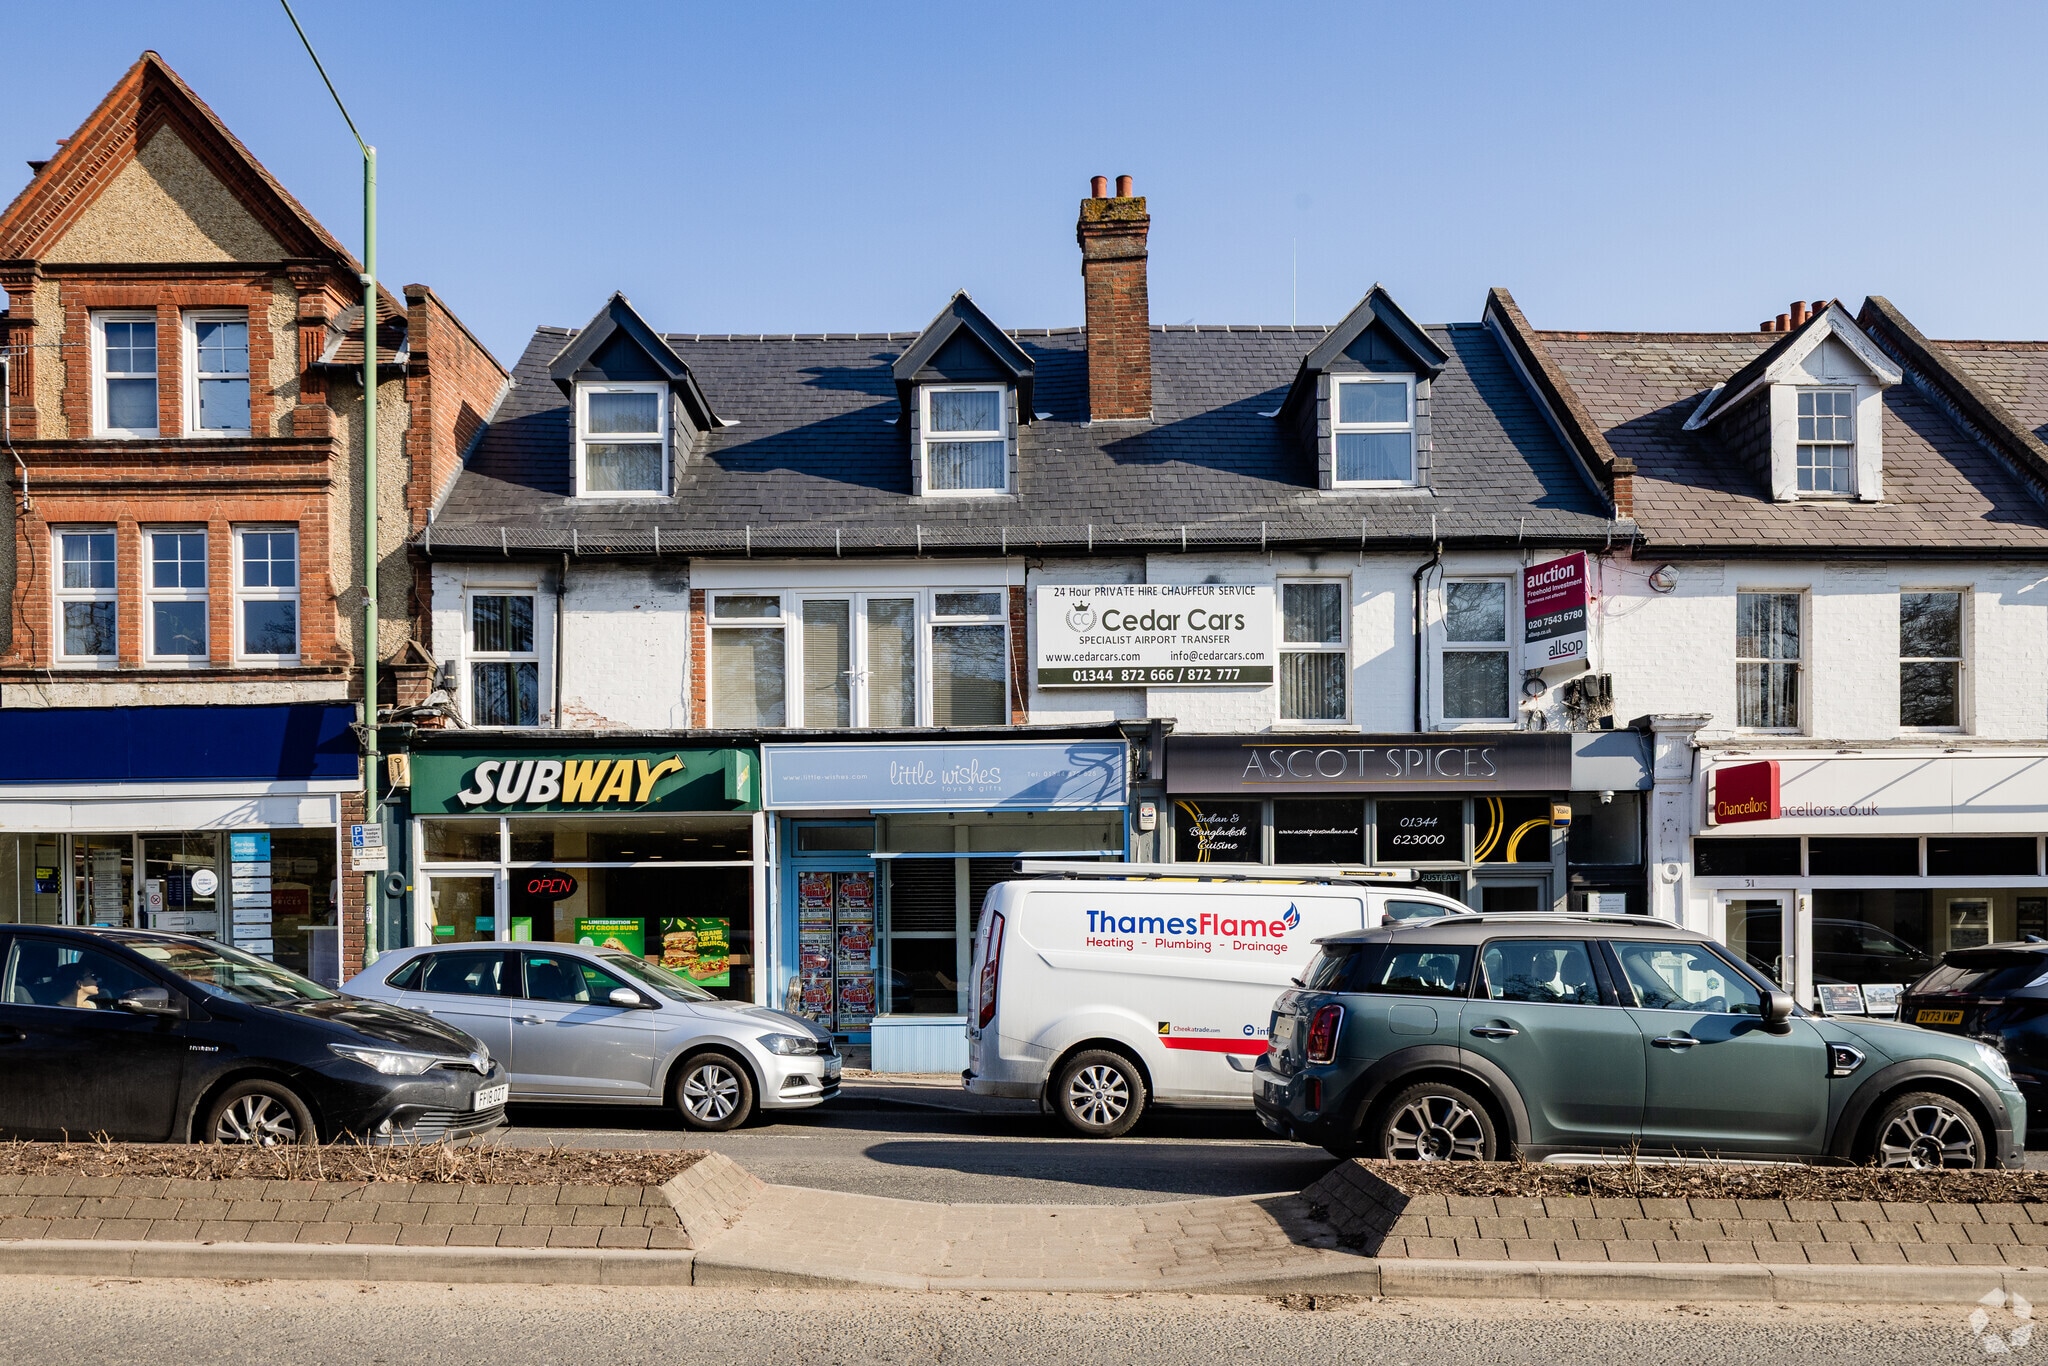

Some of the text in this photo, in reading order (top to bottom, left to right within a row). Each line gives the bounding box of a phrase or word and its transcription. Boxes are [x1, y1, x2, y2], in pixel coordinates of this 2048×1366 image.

[1527, 564, 1575, 589] auction
[1054, 585, 1256, 597] 24 Hour PRIVATE HIRE CHAUFFEUR SERVICE
[1527, 577, 1583, 598] Freehold Investment
[1101, 608, 1246, 632] Cedar Cars
[1528, 609, 1583, 630] 020 7543 6780
[1079, 634, 1231, 645] SPECIALIST AIRPORT TRANSFER
[1528, 628, 1552, 638] allsop.co.uk
[1549, 639, 1583, 656] allsop
[1045, 650, 1265, 663] www.cedarcars.com info@cedarcars.com
[1072, 667, 1241, 683] 01344 872 666 / 872 777
[1242, 746, 1498, 779] ASCOT SPICES
[782, 773, 869, 781] www.little-wishes.com
[890, 760, 937, 786] little
[942, 757, 1002, 786] wishes
[457, 753, 686, 808] SUBWAY
[941, 785, 963, 793] toys
[979, 784, 1002, 794] gifts
[1556, 807, 1569, 815] Yale
[1717, 796, 1768, 817] Chancellors
[1196, 813, 1240, 824] Indian &
[1399, 817, 1439, 828] 01344
[355, 827, 362, 835] P
[1188, 825, 1248, 840] Bangladesh
[1197, 839, 1239, 851] Cuisine
[1392, 834, 1446, 846] 623000
[1422, 873, 1456, 882] JUST EAT
[1744, 879, 1755, 888] 31
[527, 878, 573, 894] OPEN
[1086, 909, 1287, 938] ThamesFlame
[700, 929, 723, 937] CRANK
[1086, 937, 1134, 951] Heating
[1154, 938, 1212, 953] Plumbing
[1233, 940, 1289, 955] Drainage
[1919, 1010, 1961, 1023] DY73 VWP
